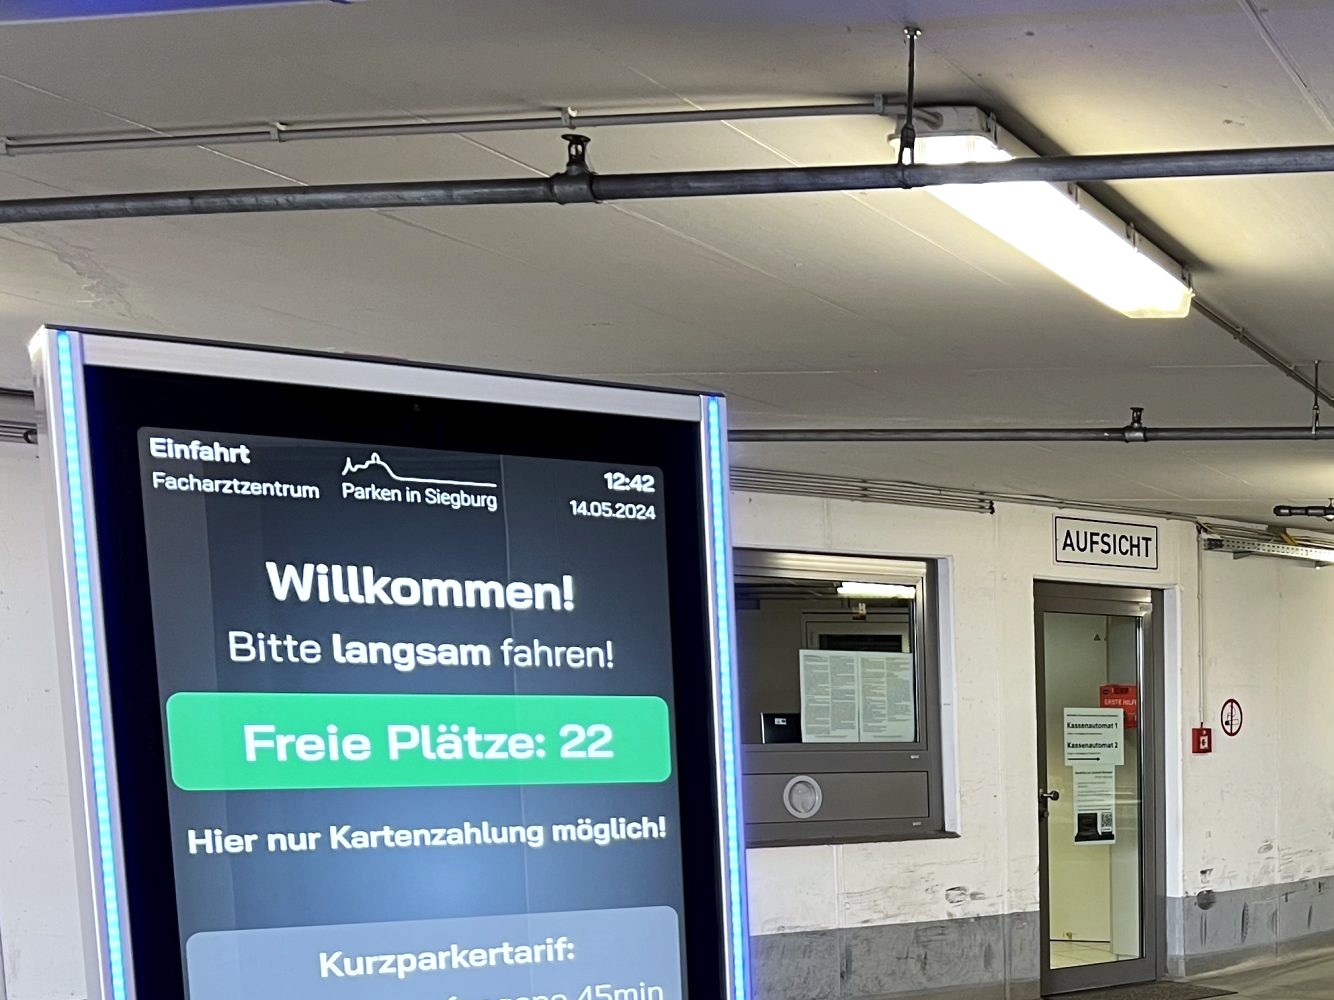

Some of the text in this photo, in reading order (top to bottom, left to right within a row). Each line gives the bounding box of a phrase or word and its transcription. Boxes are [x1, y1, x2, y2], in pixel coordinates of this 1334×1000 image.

[149, 437, 251, 464] Einfahrt
[152, 471, 320, 499] Facharztzentrum
[342, 482, 498, 512] Parken in Siegburg
[604, 472, 656, 493] 12:42
[569, 500, 656, 520] 14.05.2024
[1061, 529, 1152, 558] AUFSICHT
[265, 561, 575, 611] Willkommen!
[228, 631, 614, 671] Bitte langsam fahren!
[243, 723, 614, 762] Freie Plätze: 22
[187, 816, 667, 854] Hier nur Kartenzahlung möglich!
[319, 937, 575, 978] Kurzparkertarif:
